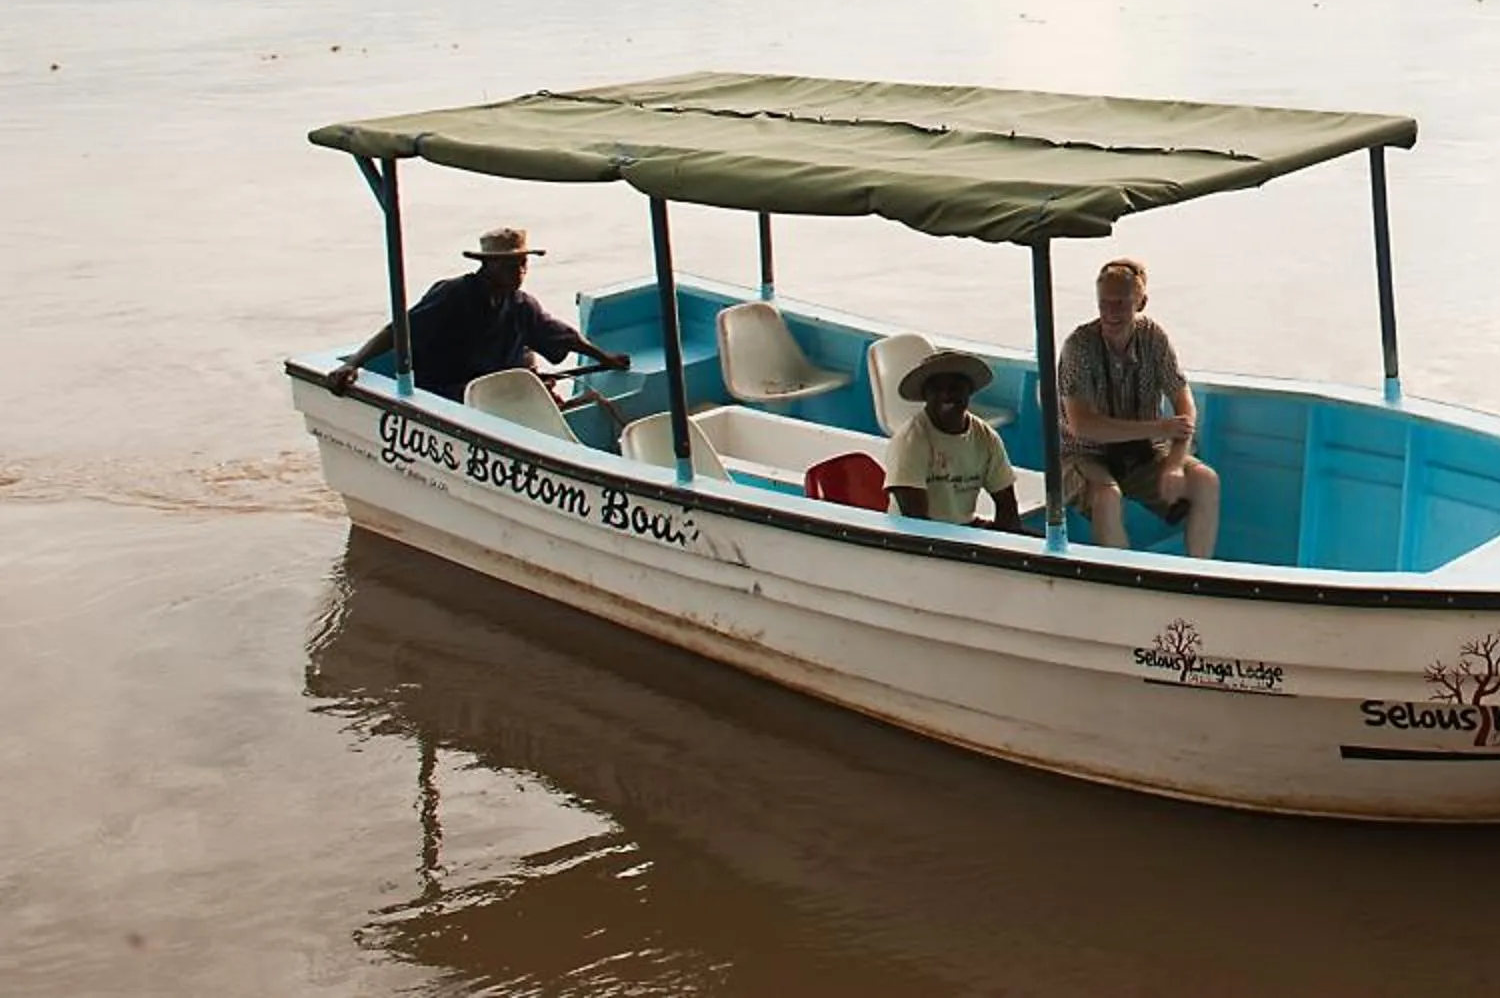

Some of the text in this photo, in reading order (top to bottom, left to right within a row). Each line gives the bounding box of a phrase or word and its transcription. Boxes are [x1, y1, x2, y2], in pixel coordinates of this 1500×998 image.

[379, 409, 461, 470] Glass
[466, 442, 591, 517] Bottom
[1133, 647, 1181, 671] Selous
[1235, 659, 1284, 689] Lodge
[1359, 699, 1478, 732] Selous
